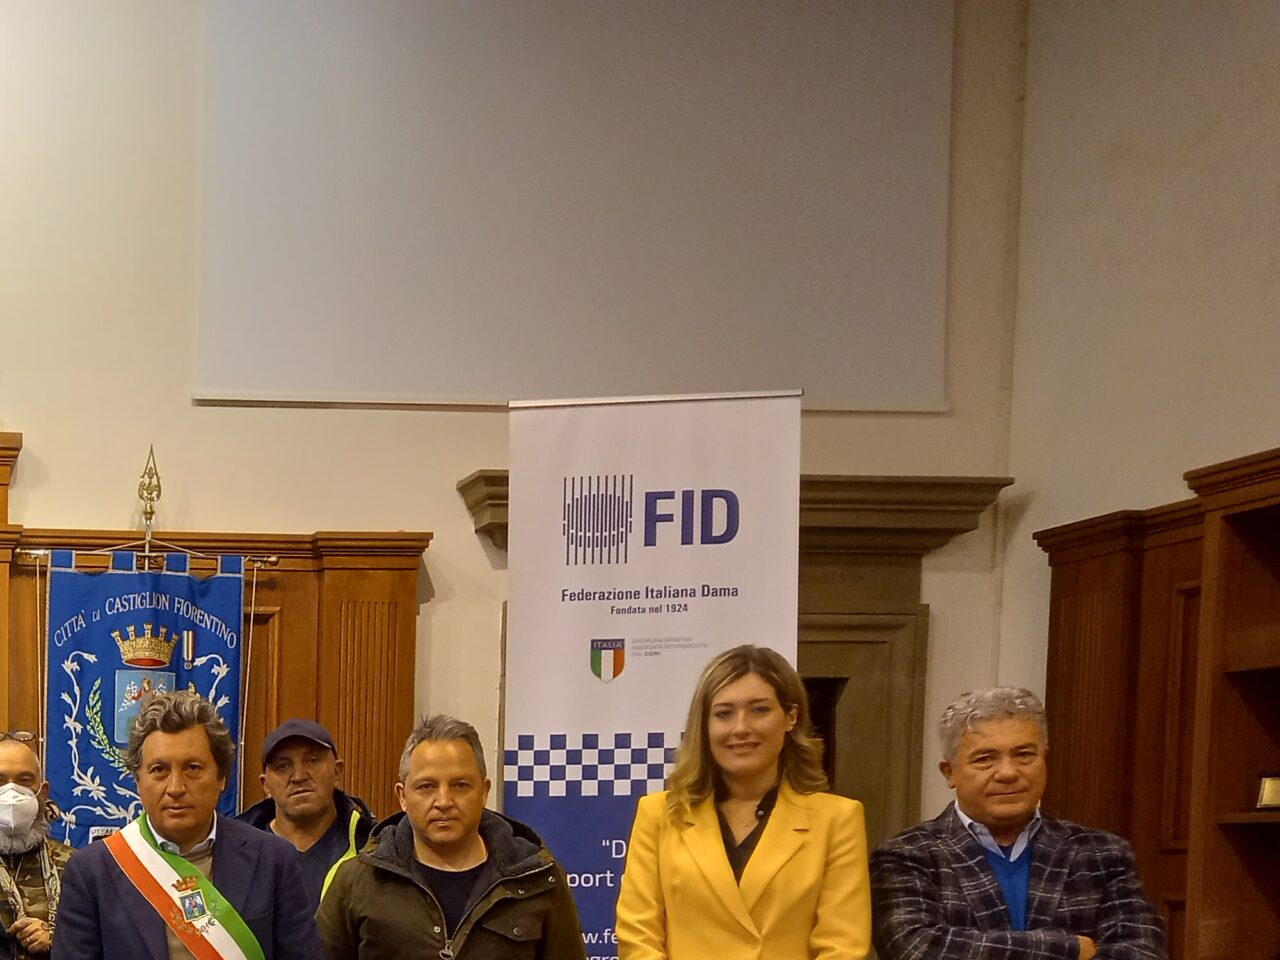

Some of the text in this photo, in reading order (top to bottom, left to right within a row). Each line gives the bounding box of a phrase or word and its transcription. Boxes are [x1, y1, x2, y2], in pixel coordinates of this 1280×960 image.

[643, 488, 740, 547] FID
[561, 584, 738, 602] Federazione Italiana Dama
[610, 604, 688, 614] Fondata nel 1924
[105, 591, 170, 616] CASTIGLION
[174, 596, 237, 649] FIORENTINO
[593, 640, 623, 649] ITALIA
